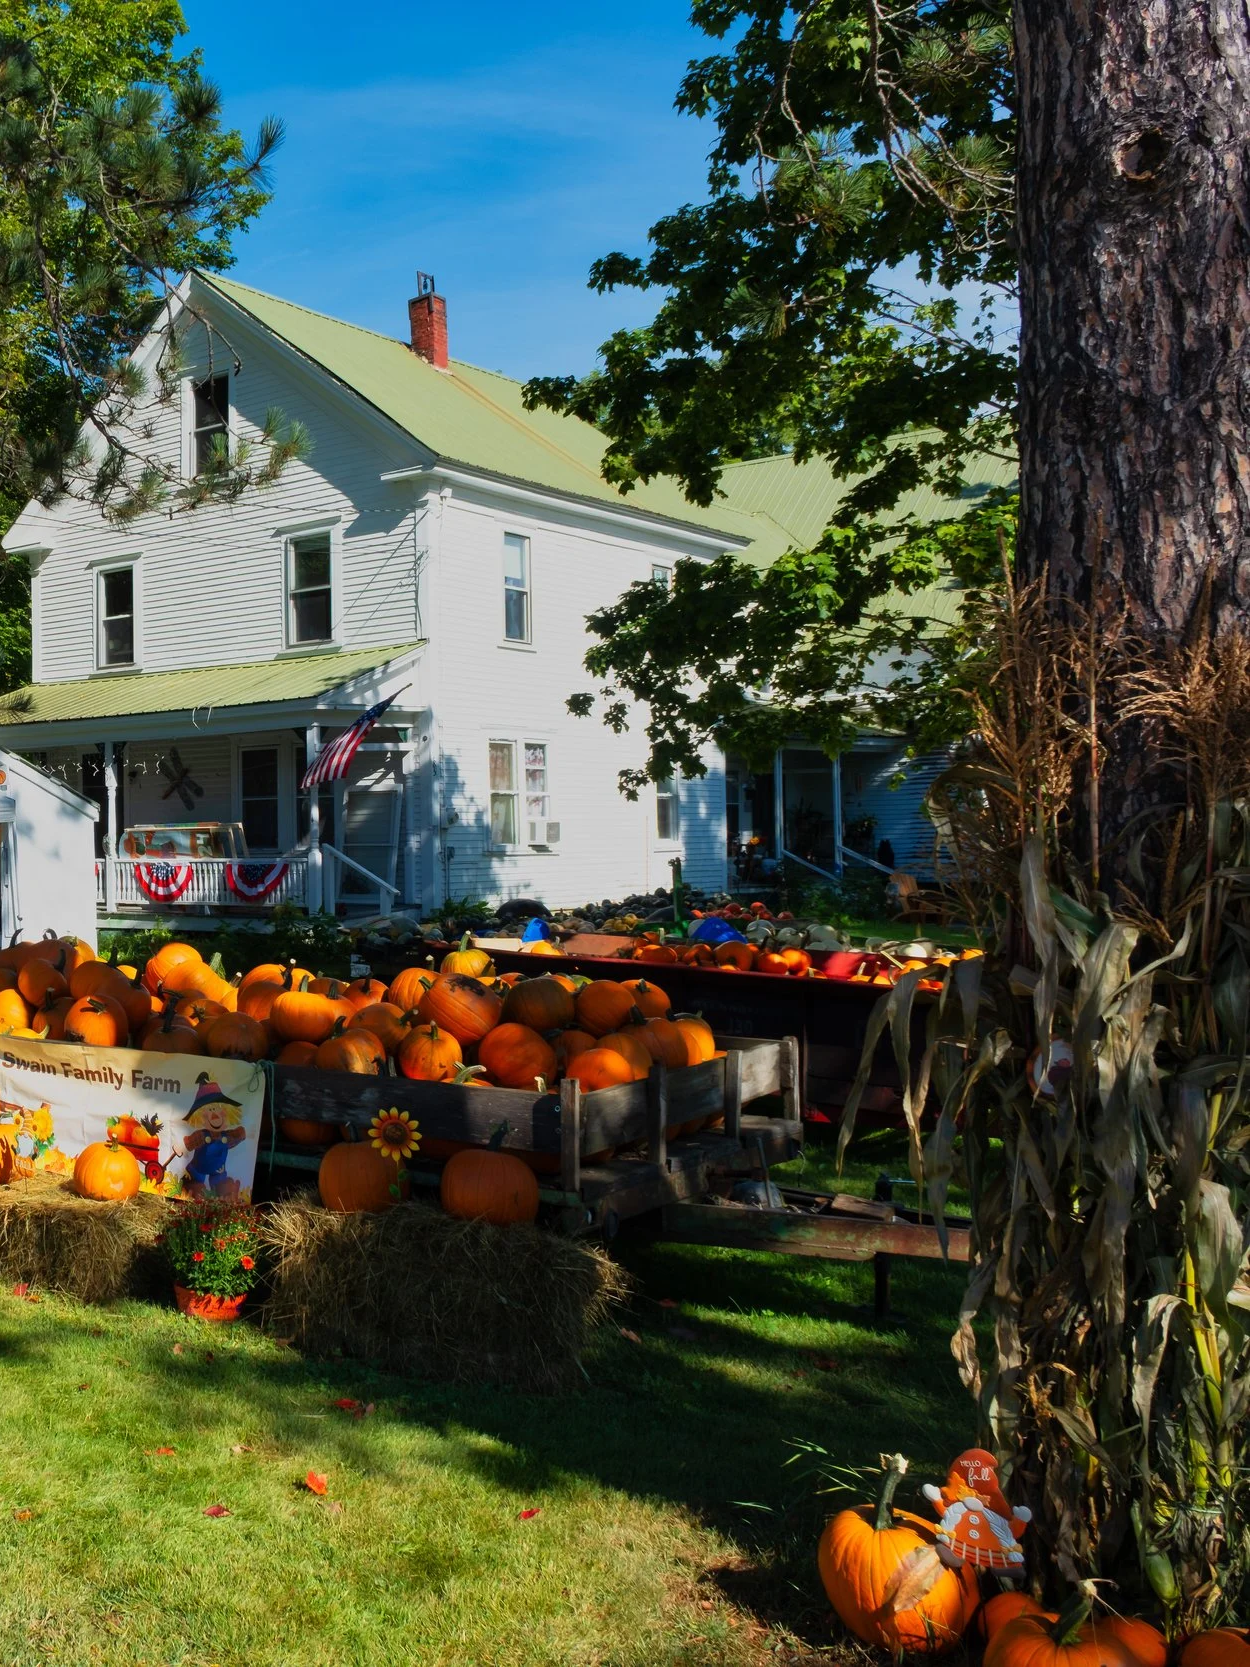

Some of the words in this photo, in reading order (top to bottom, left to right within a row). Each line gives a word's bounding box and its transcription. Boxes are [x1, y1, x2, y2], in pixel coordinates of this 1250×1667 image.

[1, 1051, 57, 1076] Swain
[61, 1062, 124, 1091] Family
[131, 1069, 181, 1094] Farm
[967, 1467, 991, 1488] fall
